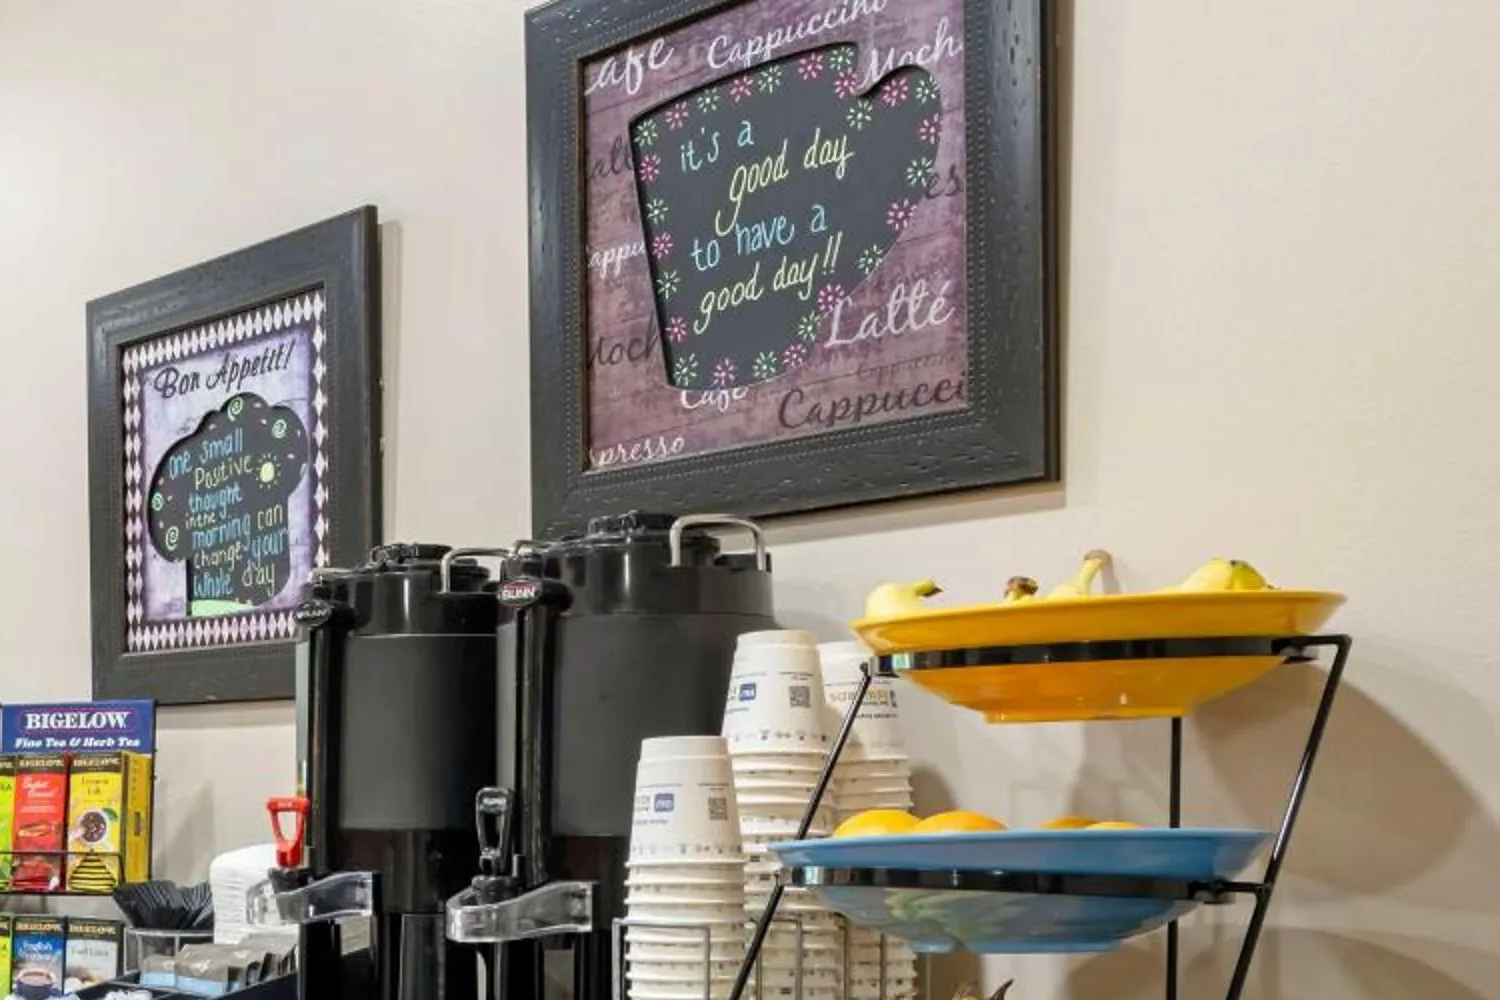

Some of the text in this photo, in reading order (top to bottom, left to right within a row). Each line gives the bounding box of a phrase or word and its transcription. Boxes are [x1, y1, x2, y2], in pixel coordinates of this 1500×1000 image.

[707, 0, 887, 68] Cappuccino
[680, 120, 755, 172] it's a
[715, 127, 856, 236] good day
[586, 240, 647, 279] appu
[690, 203, 828, 272] to have a
[693, 261, 764, 335] good
[823, 278, 956, 348] Latté
[154, 339, 296, 399] Bon Appetit!
[257, 504, 283, 530] can
[14, 738, 42, 748] Fine
[45, 738, 67, 748] Tea
[83, 737, 115, 747] Herb
[118, 736, 141, 747] Tea
[25, 712, 131, 729] BIGELOW
